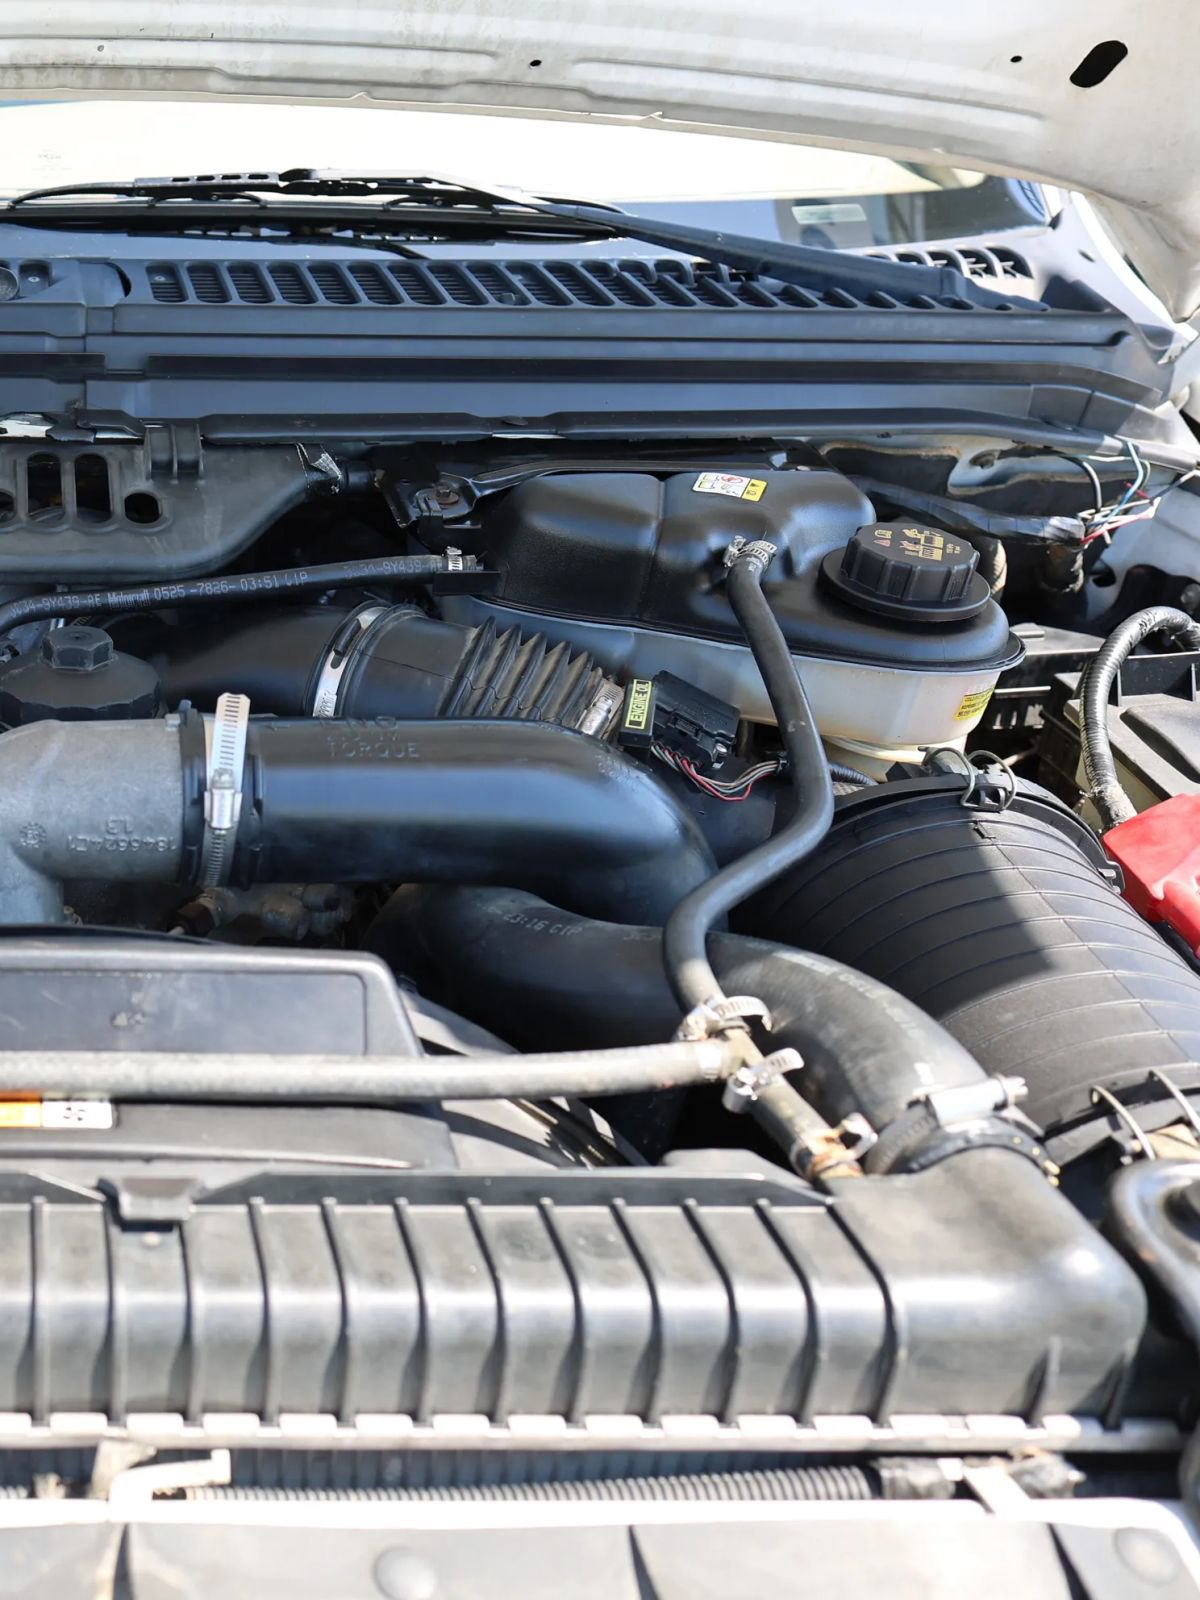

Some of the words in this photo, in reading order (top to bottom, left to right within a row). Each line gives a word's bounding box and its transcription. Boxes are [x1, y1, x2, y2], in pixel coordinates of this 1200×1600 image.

[153, 584, 185, 601] 0525
[239, 574, 280, 591] 03:51
[630, 692, 647, 721] ENGINE
[328, 742, 421, 760] TORQUE
